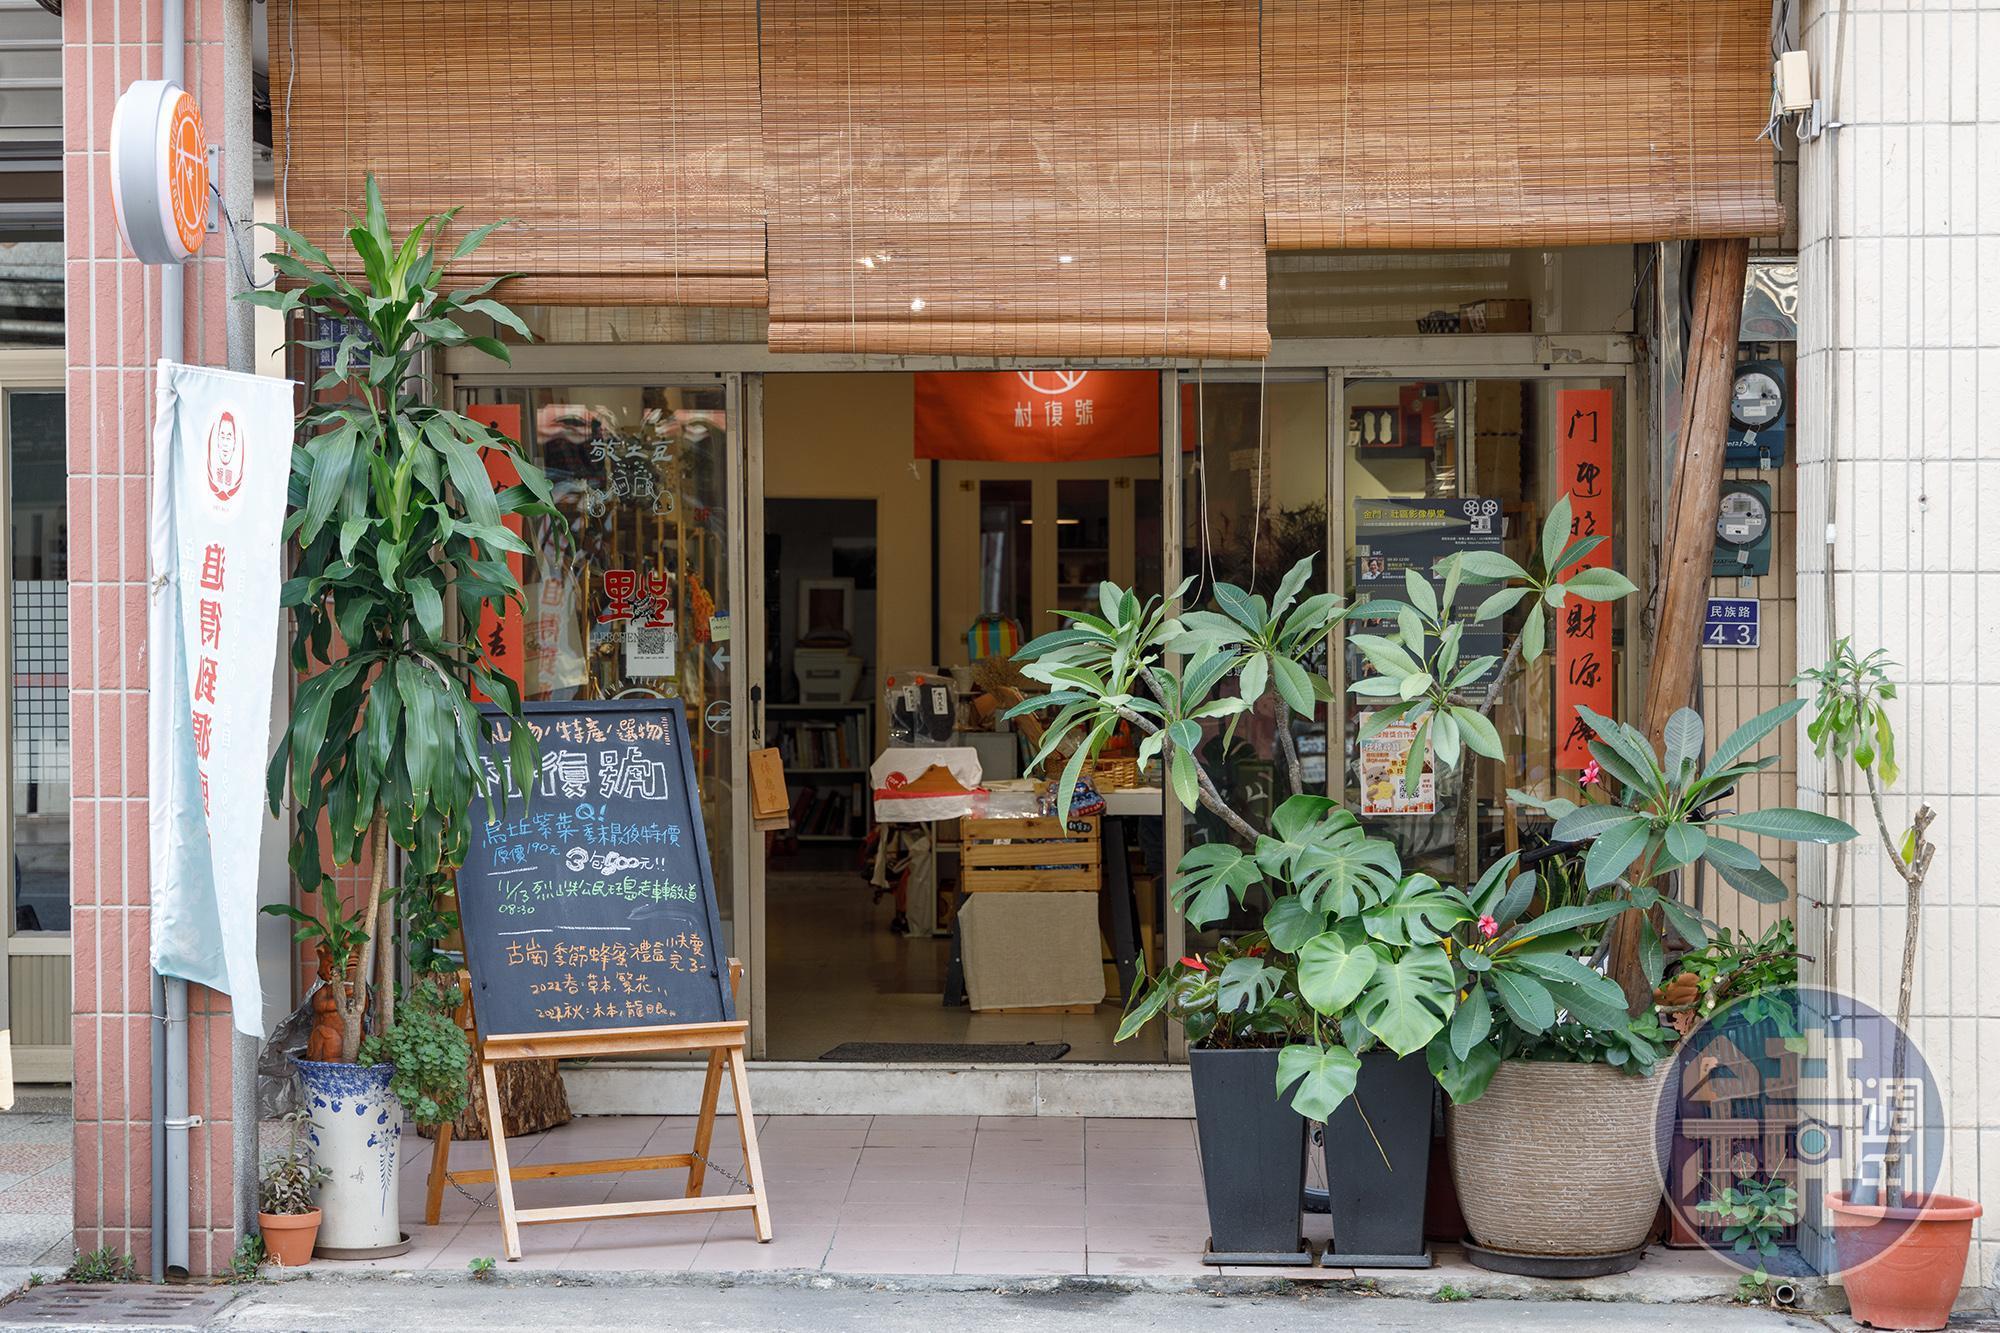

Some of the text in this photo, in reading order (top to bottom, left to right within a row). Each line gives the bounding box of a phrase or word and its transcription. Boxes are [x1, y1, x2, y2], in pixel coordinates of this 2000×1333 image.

[1013, 399, 1094, 428] 村復號
[589, 438, 675, 463] 敬土豆
[1710, 605, 1750, 618] 民族路
[1709, 624, 1751, 645] 43
[603, 680, 625, 697] IVA
[498, 904, 535, 915] 08:30
